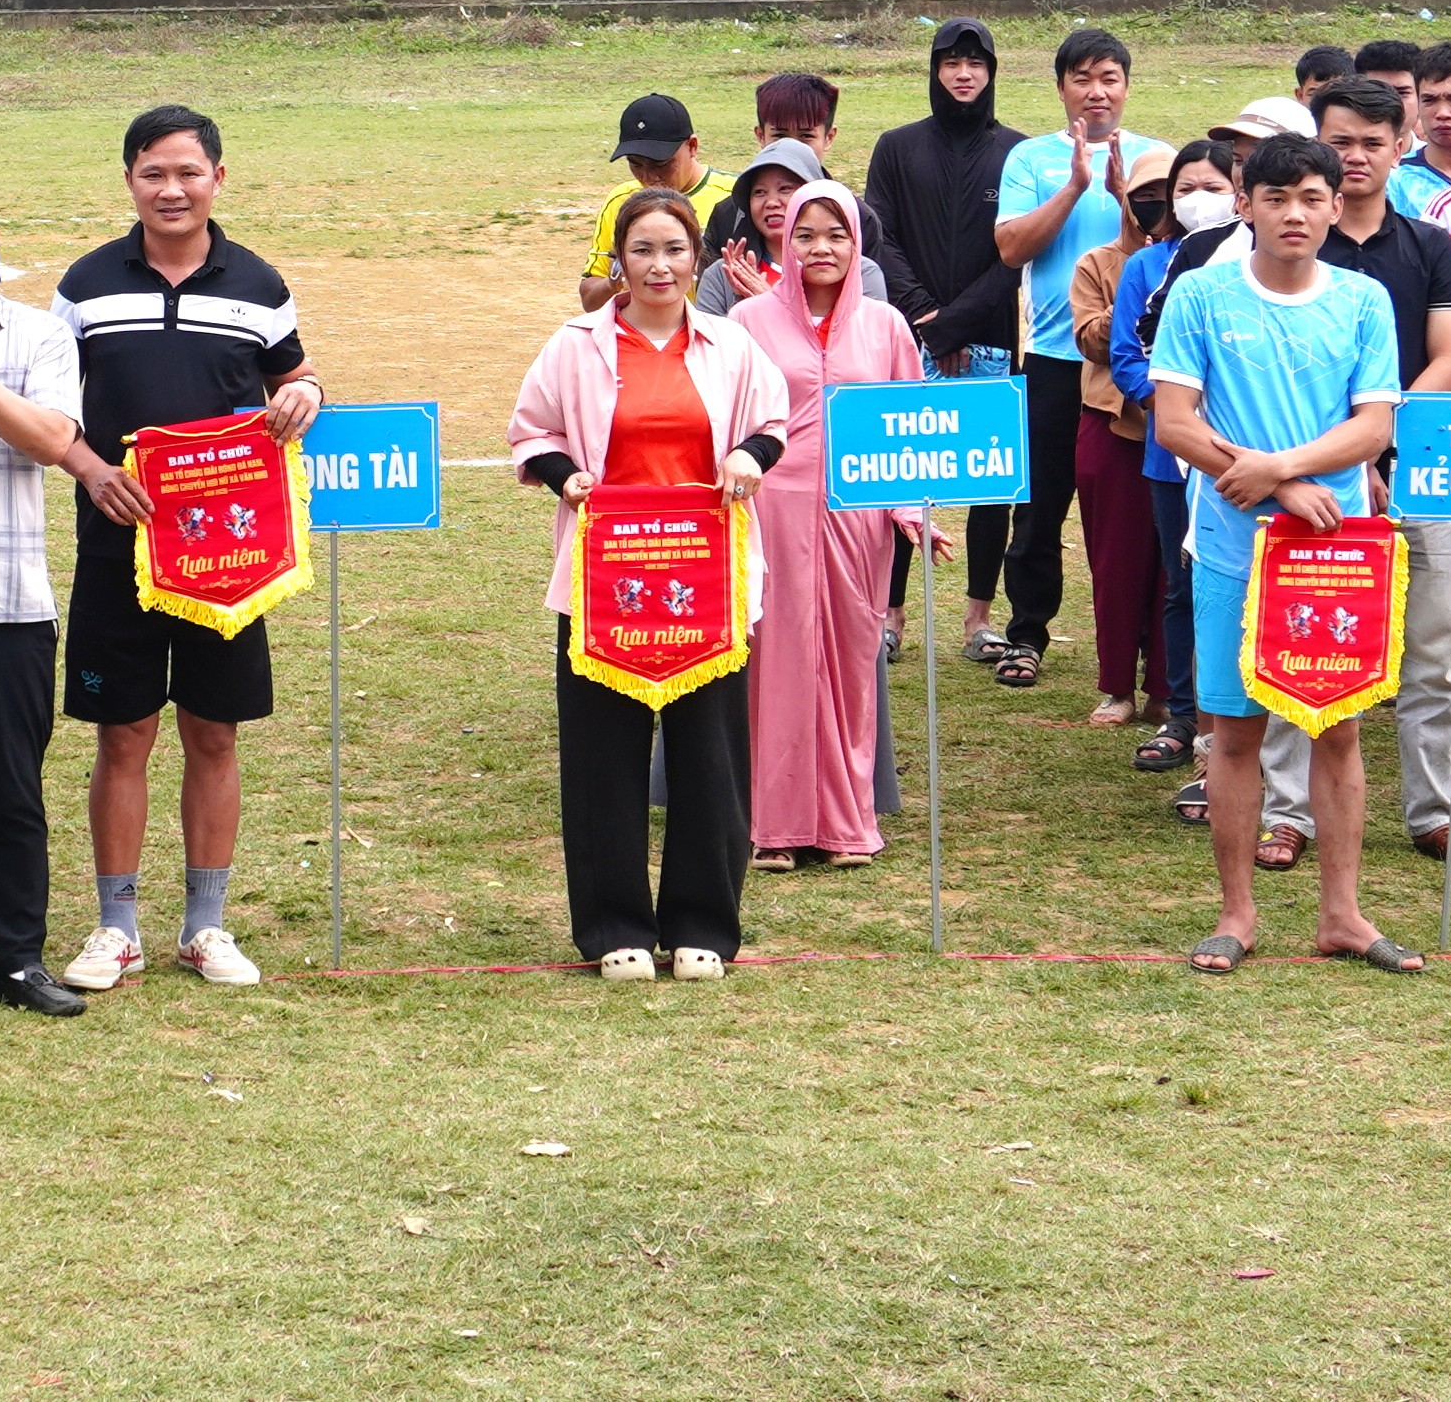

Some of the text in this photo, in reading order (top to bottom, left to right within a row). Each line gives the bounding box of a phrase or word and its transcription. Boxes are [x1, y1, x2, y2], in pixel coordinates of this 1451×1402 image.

[881, 406, 960, 437] THÔN
[167, 444, 252, 467] BAN TỔ CHỨC
[368, 444, 418, 489] TÀI
[840, 435, 1014, 483] CHUÔNG CẢI
[613, 518, 698, 535] BAN TỔ CHỨC
[176, 547, 270, 580] Lưu niệm
[1289, 546, 1365, 561] BAN TỔ CHỨC
[610, 625, 706, 652] Lưu niệm
[1277, 650, 1362, 676] Lưu niệm
